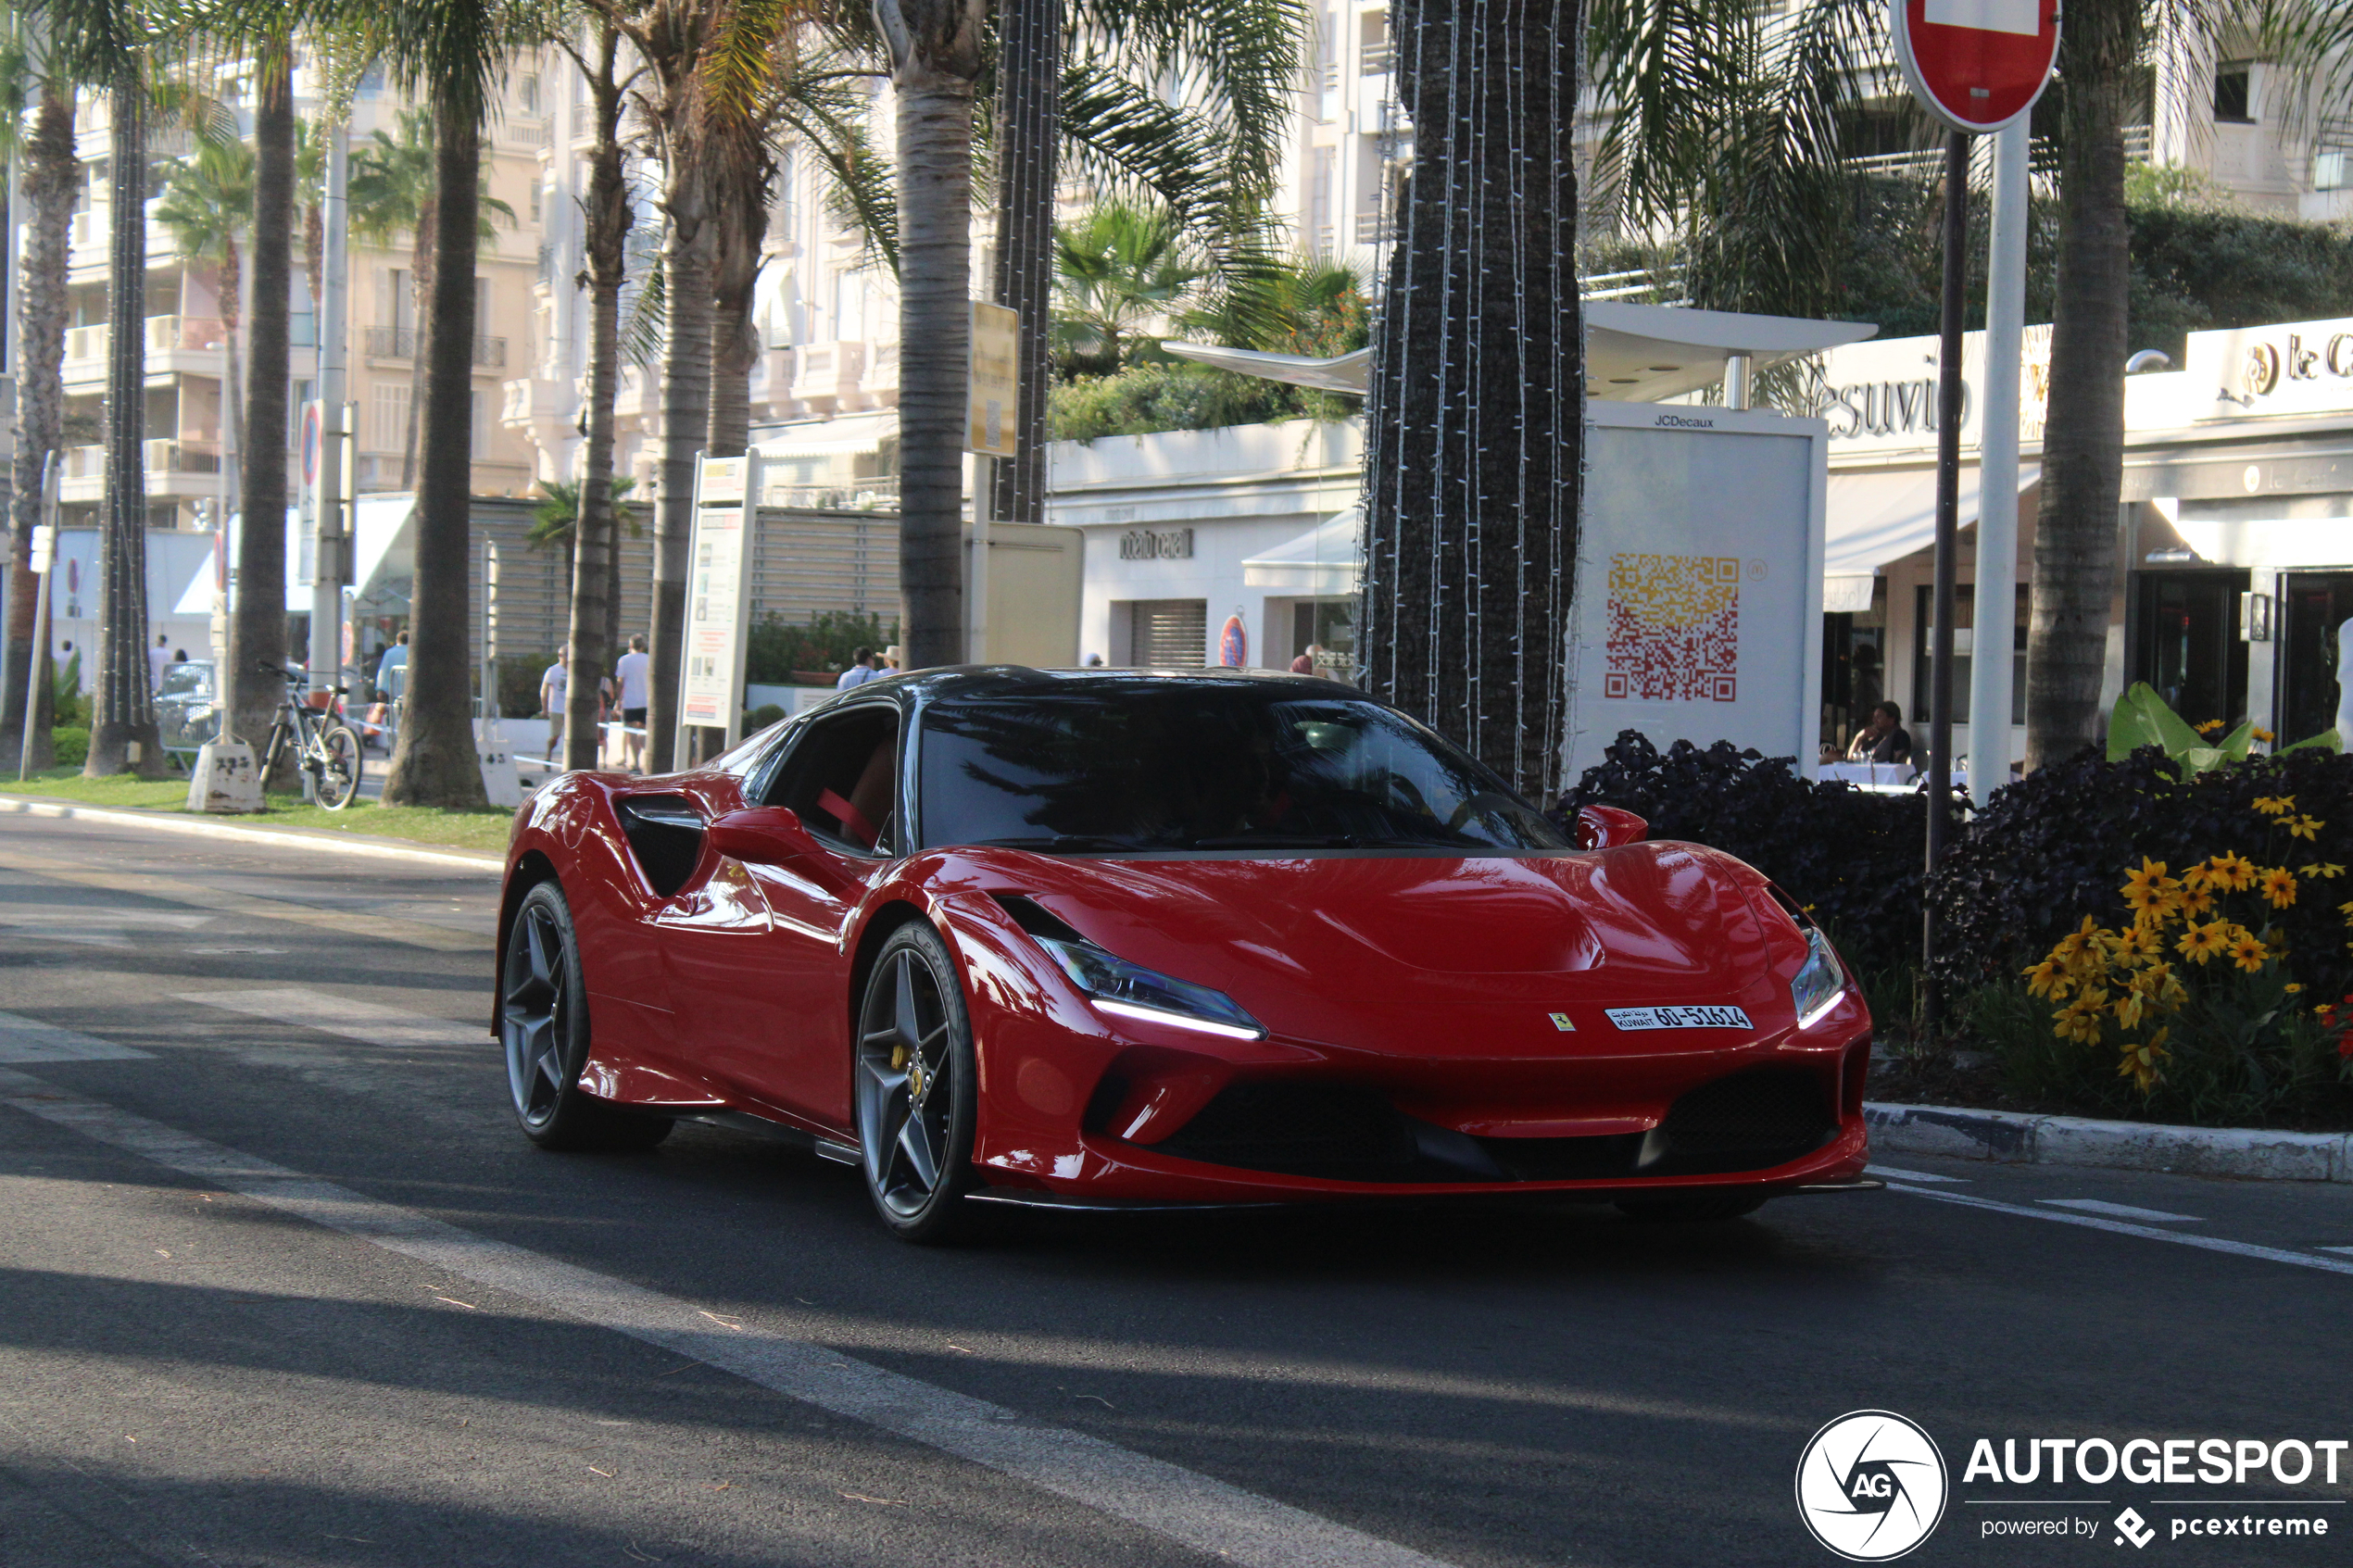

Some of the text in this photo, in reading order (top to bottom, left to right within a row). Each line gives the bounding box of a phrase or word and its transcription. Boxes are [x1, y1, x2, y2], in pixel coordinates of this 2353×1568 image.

[2323, 332, 2353, 379] C
[1809, 355, 1972, 439] esuvi
[1655, 415, 1714, 428] JCDecaux
[1617, 1018, 1655, 1028] KUWAIT
[1654, 1007, 1749, 1027] 60-51614
